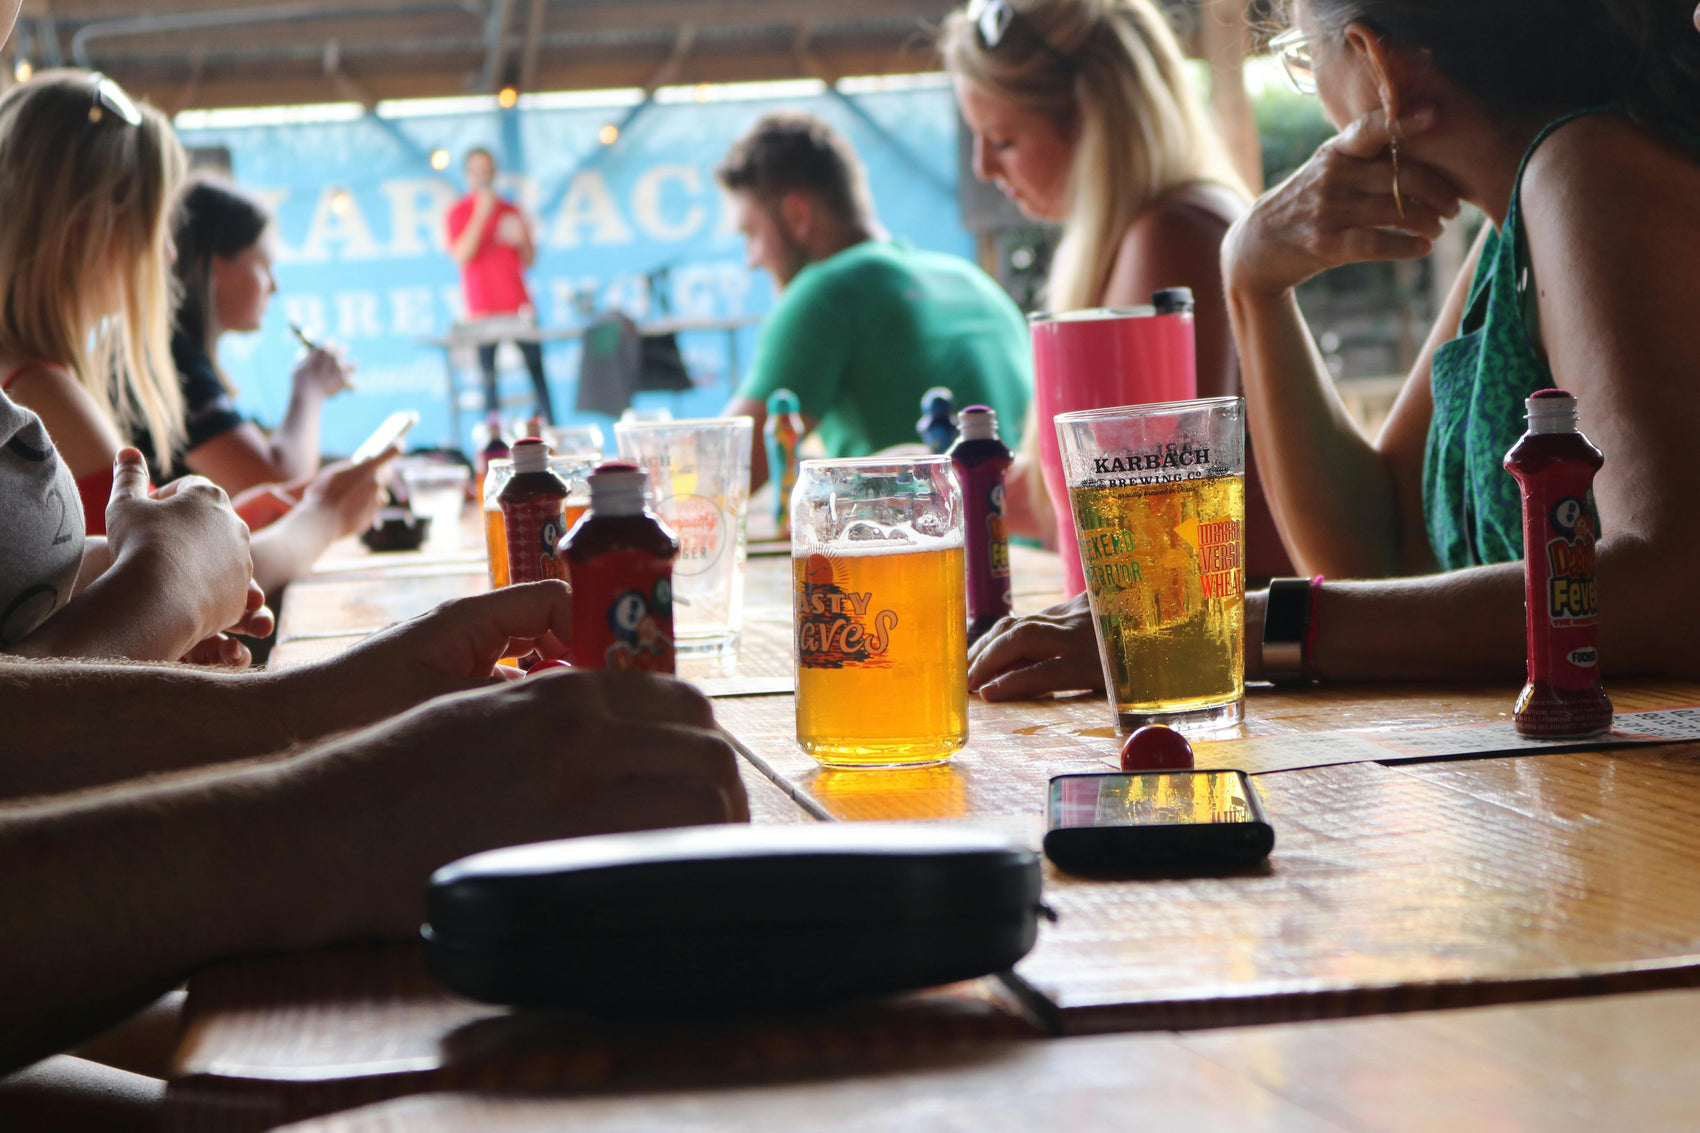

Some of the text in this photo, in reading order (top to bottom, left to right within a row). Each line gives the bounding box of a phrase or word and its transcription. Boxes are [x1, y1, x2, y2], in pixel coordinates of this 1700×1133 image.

[1093, 448, 1211, 474] KARBACH
[1109, 473, 1182, 488] BREWING
[1086, 561, 1144, 588] ARRIOR
[1199, 569, 1242, 600] WHEAT
[800, 592, 872, 616] ASTY
[1553, 579, 1597, 613] Feve
